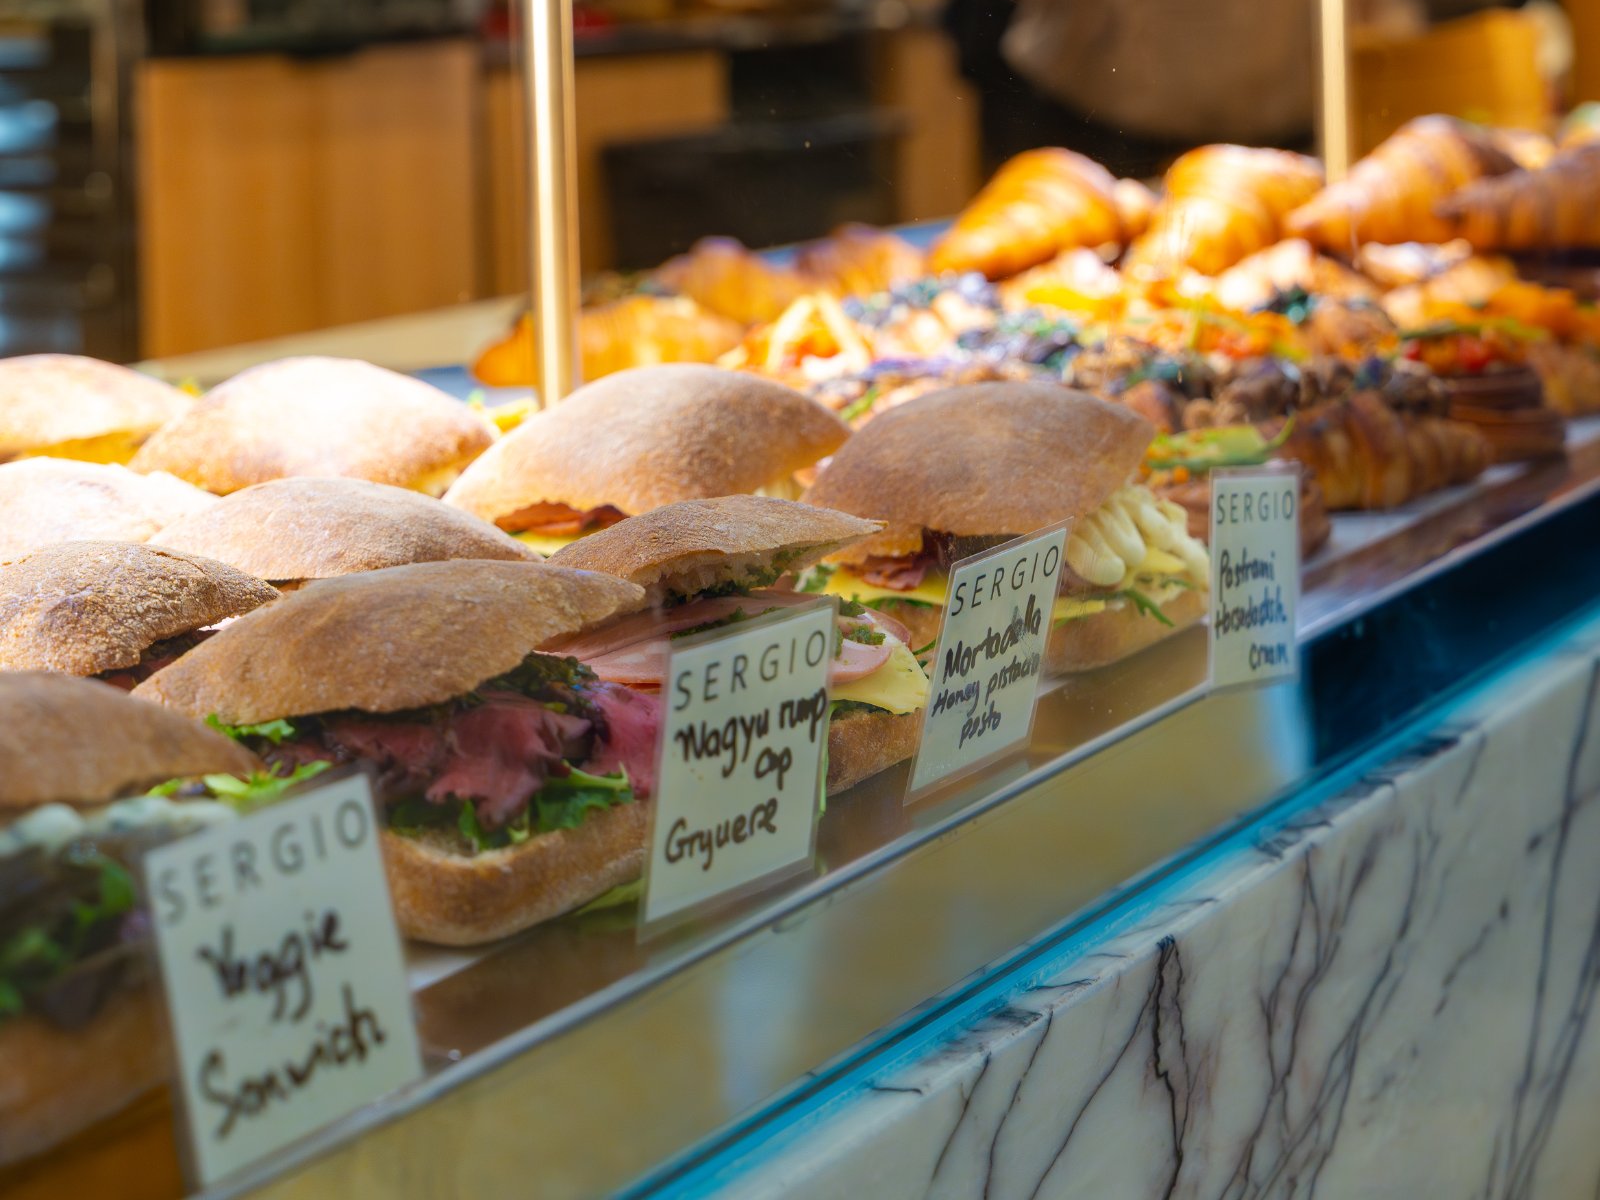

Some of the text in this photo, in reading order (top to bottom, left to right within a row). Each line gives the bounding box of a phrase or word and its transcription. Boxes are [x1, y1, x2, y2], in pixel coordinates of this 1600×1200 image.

[1216, 490, 1294, 524] SERGIO
[951, 545, 1059, 617] SERGIO
[674, 630, 825, 711] SERGIO
[157, 801, 368, 925] SERGIO
